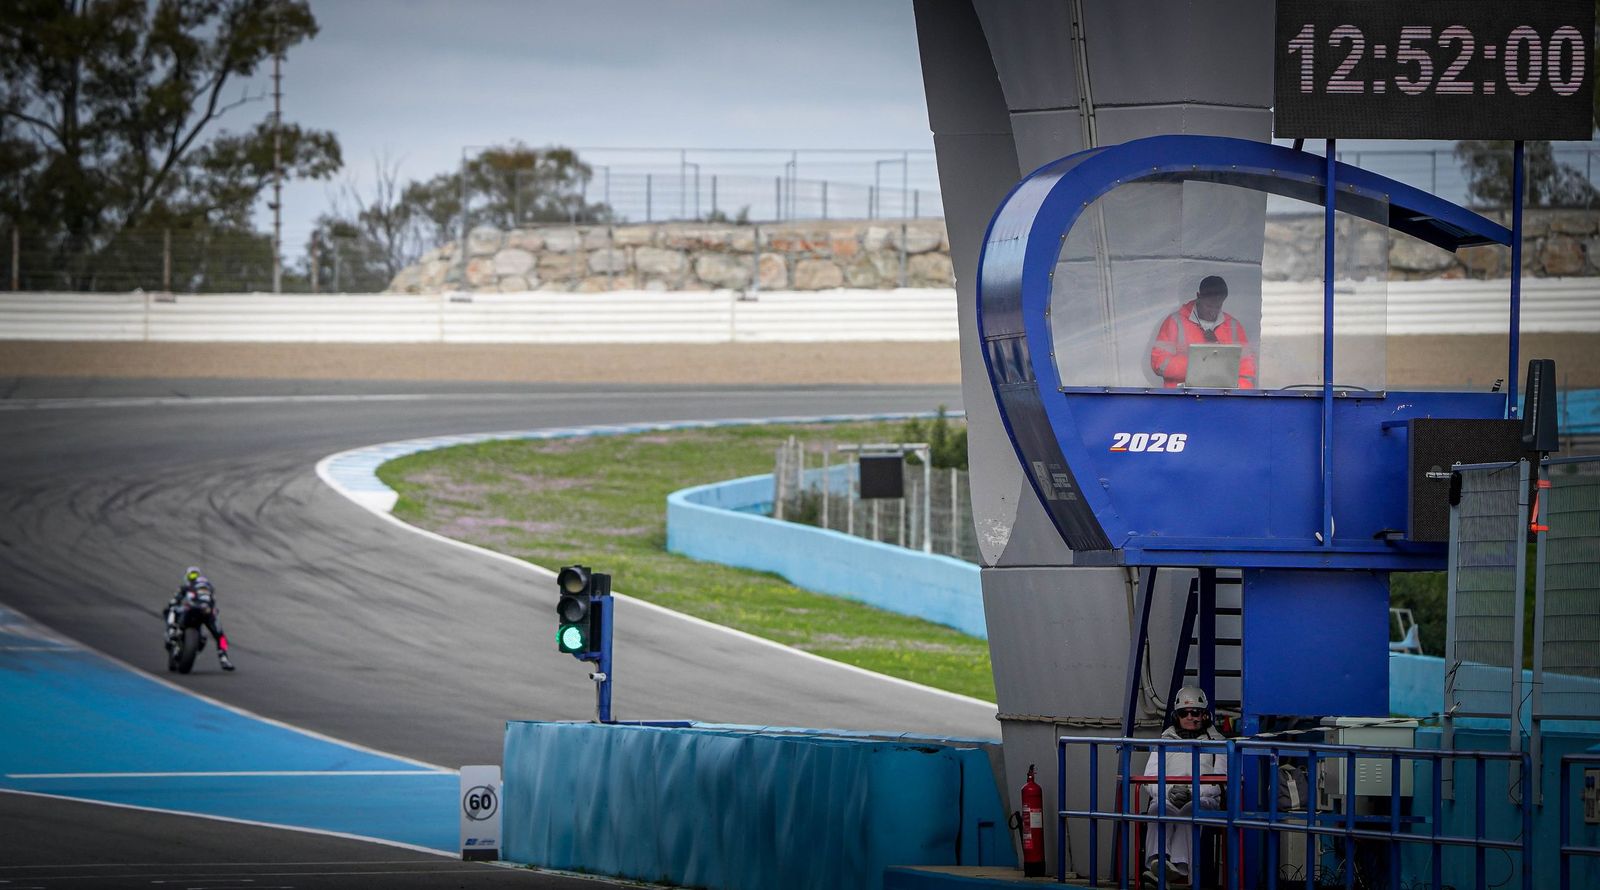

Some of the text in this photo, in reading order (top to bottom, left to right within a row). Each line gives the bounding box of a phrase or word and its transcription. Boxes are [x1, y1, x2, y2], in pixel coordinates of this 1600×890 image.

[1288, 24, 1585, 96] 12:52:00
[1110, 432, 1187, 453] 2026
[469, 793, 492, 810] 60
